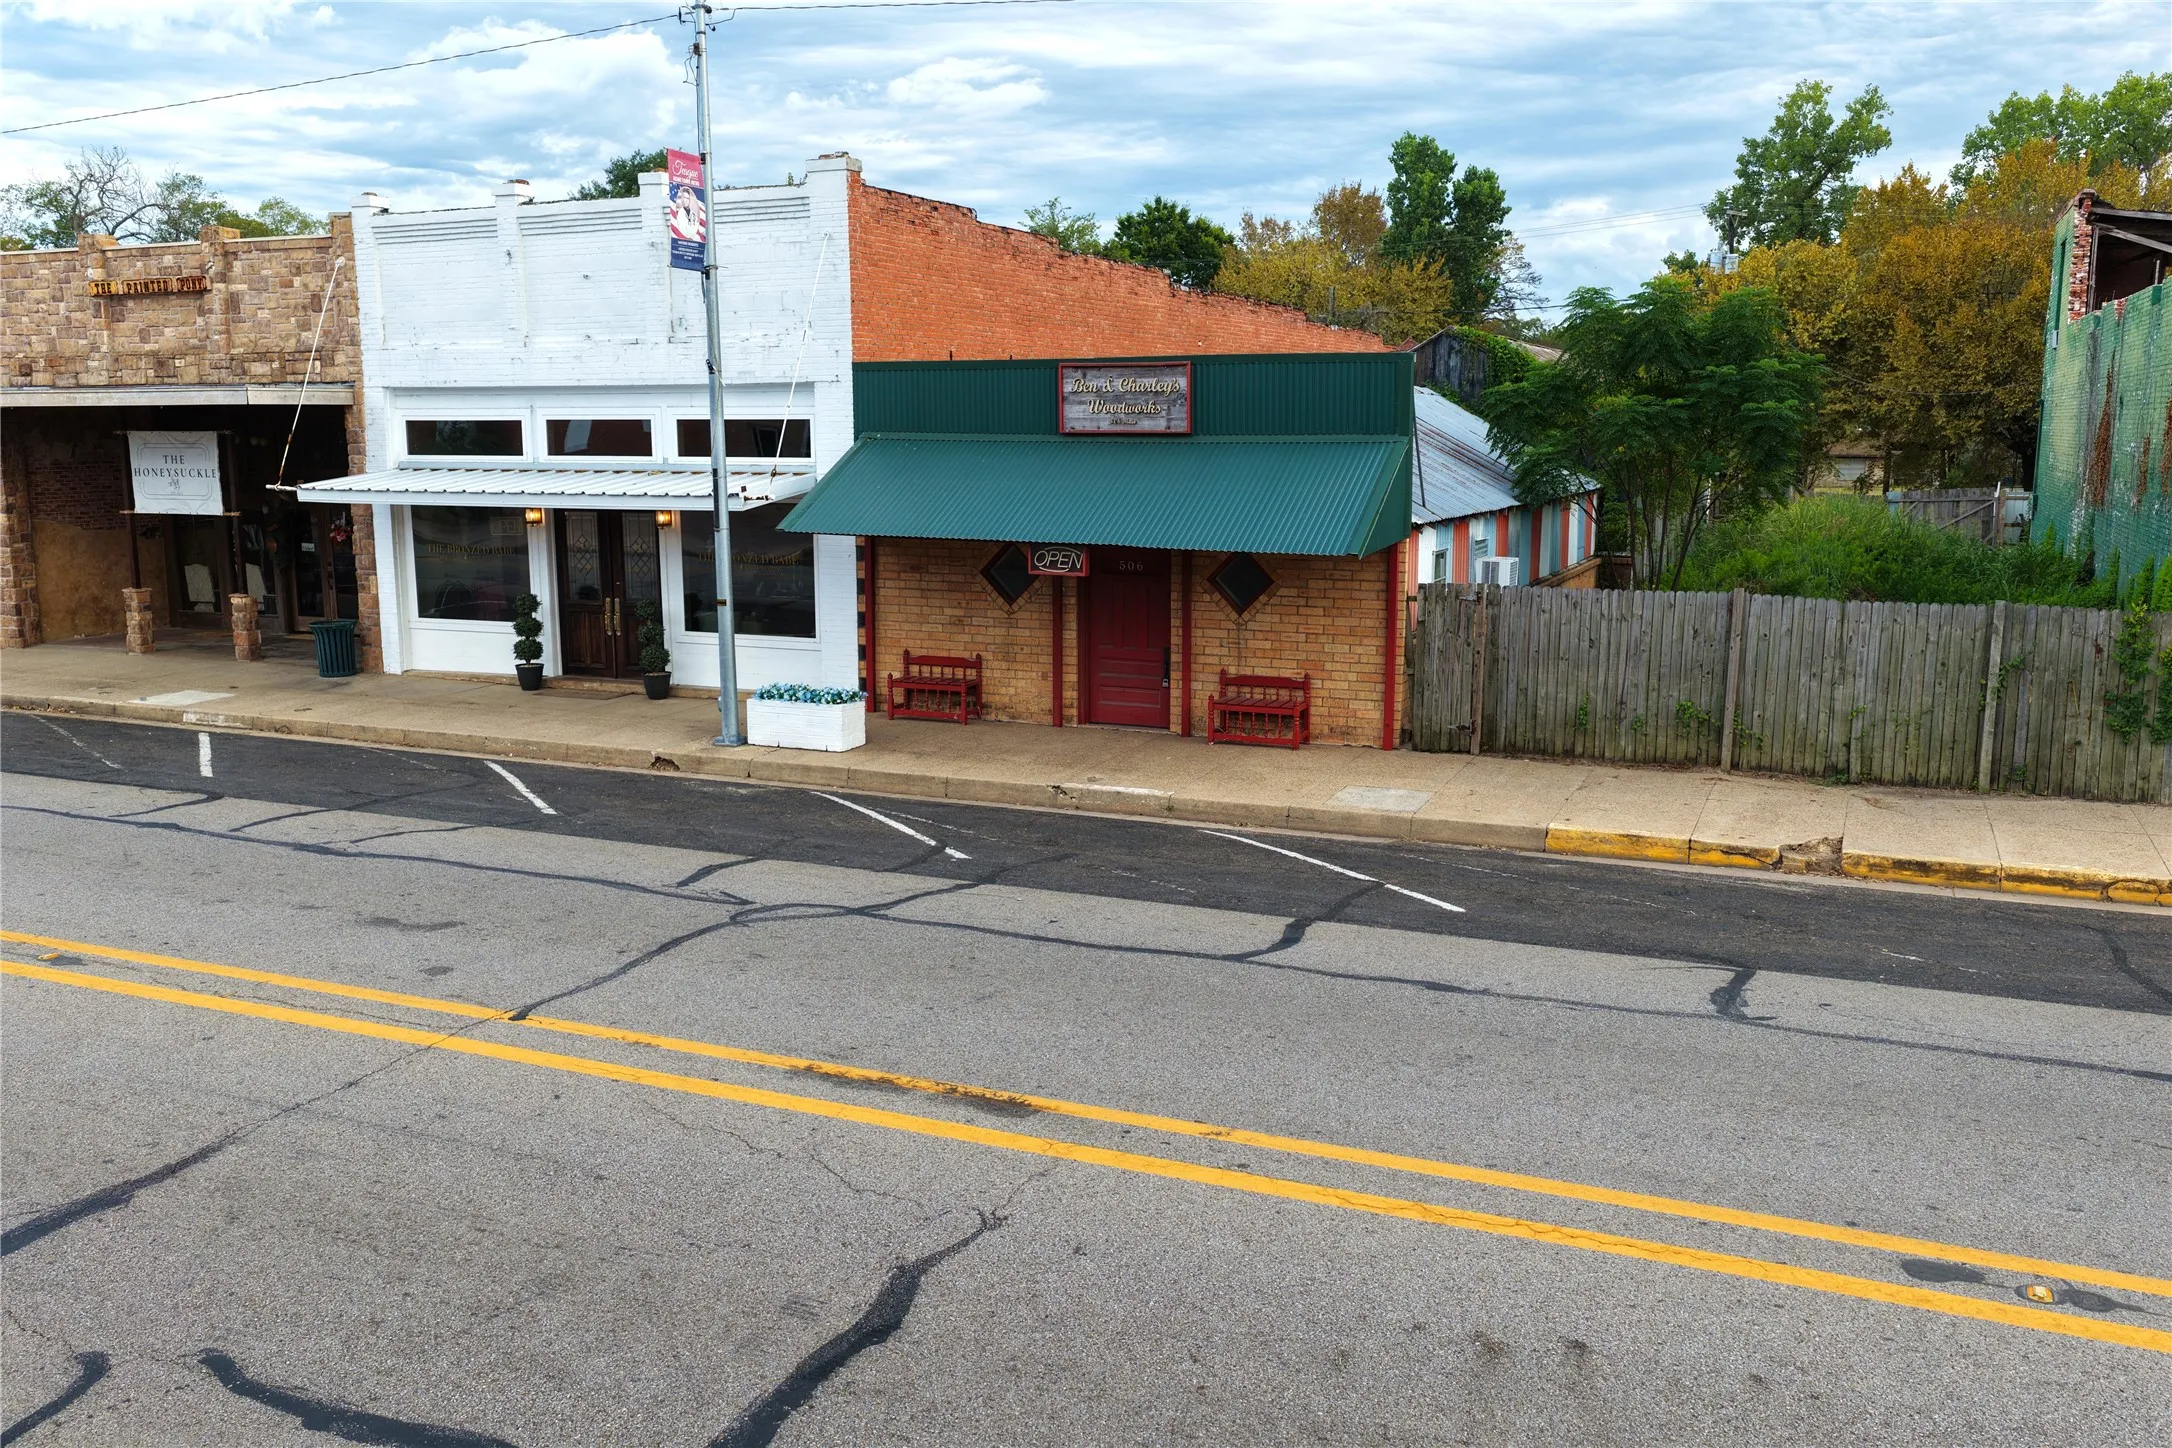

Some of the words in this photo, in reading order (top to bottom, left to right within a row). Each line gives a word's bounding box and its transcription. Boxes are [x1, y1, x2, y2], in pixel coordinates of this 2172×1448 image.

[672, 160, 699, 180] Teague
[94, 283, 112, 295] THE
[126, 280, 169, 294] PAINTED
[180, 277, 203, 290] PONY
[1071, 378, 1098, 393] Ben
[1118, 377, 1180, 396] Charley's
[1087, 399, 1162, 414] Woodworks
[162, 455, 185, 464] THE
[134, 467, 217, 478] HONEYSUCKLE
[427, 543, 445, 553] THE
[447, 544, 490, 555] BRONZED
[731, 553, 769, 564] ONZED
[772, 555, 799, 566] BABE
[1034, 550, 1084, 569] OPEN
[1119, 560, 1144, 572] 506
